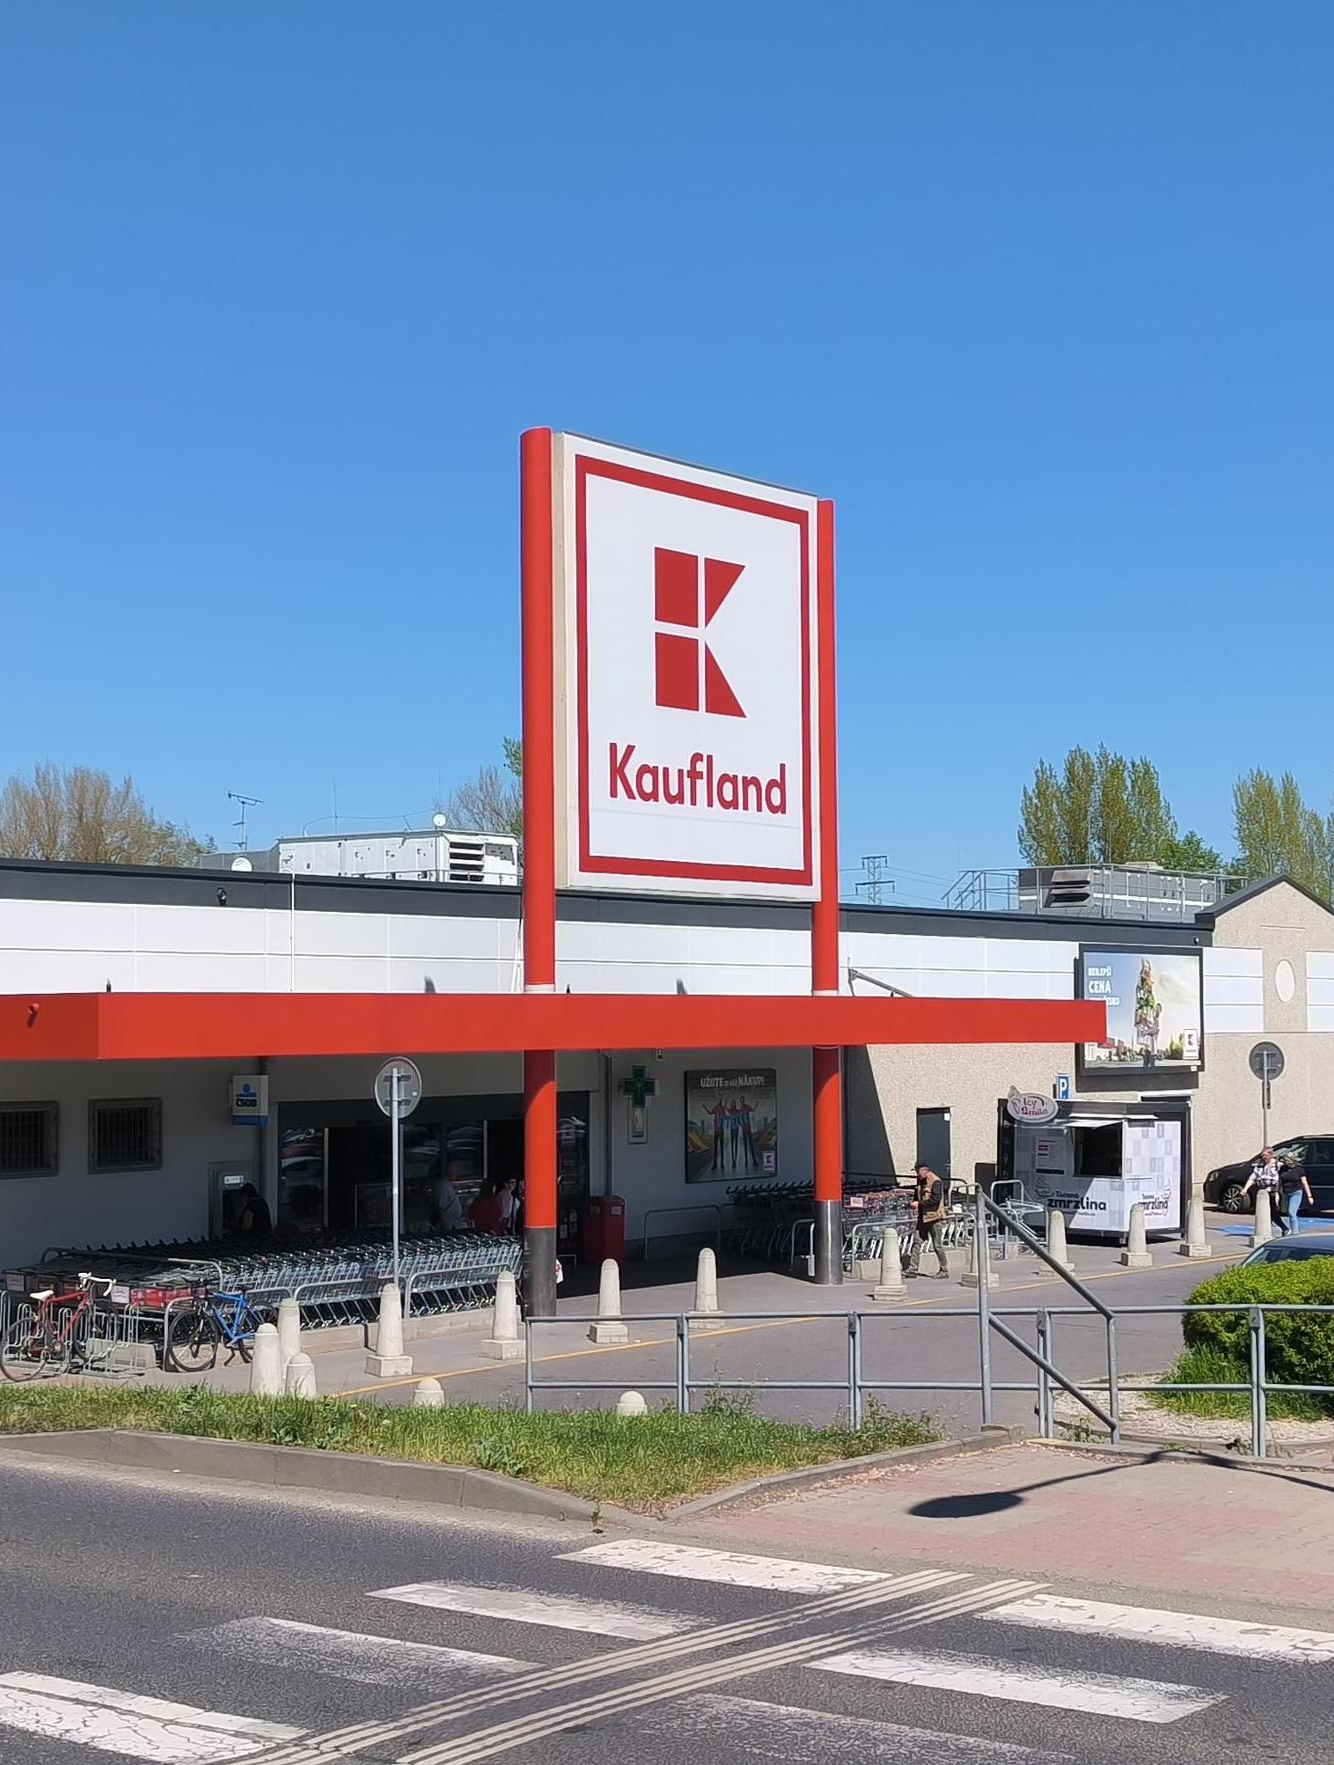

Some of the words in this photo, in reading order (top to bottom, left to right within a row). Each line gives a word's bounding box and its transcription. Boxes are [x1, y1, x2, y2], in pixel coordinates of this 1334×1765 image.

[609, 742, 787, 815] Kaufland
[1088, 980, 1111, 993] CENA
[1060, 1078, 1068, 1099] P
[1047, 1196, 1107, 1211] zmrzlina
